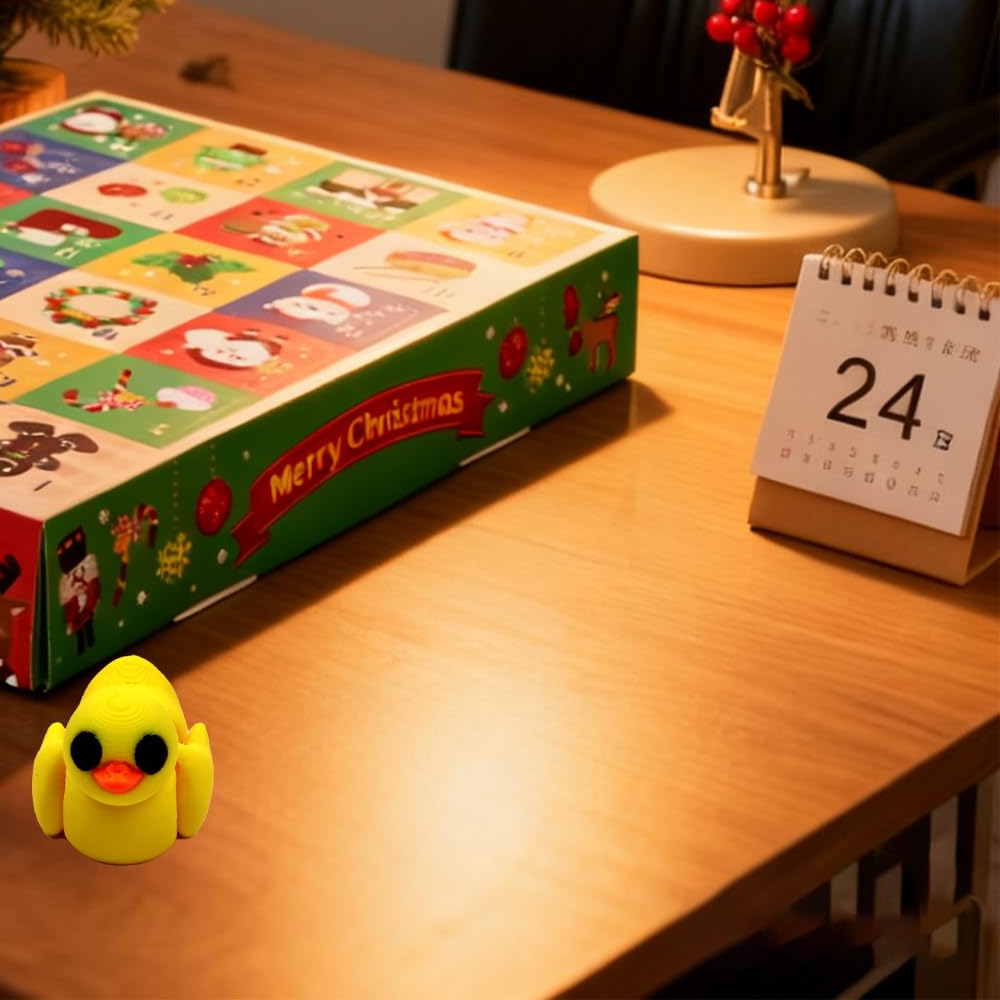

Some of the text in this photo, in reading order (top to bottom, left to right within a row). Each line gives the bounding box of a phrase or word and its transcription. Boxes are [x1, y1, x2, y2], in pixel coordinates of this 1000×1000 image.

[269, 390, 465, 504] Merry Christmas
[825, 356, 926, 441] 24
